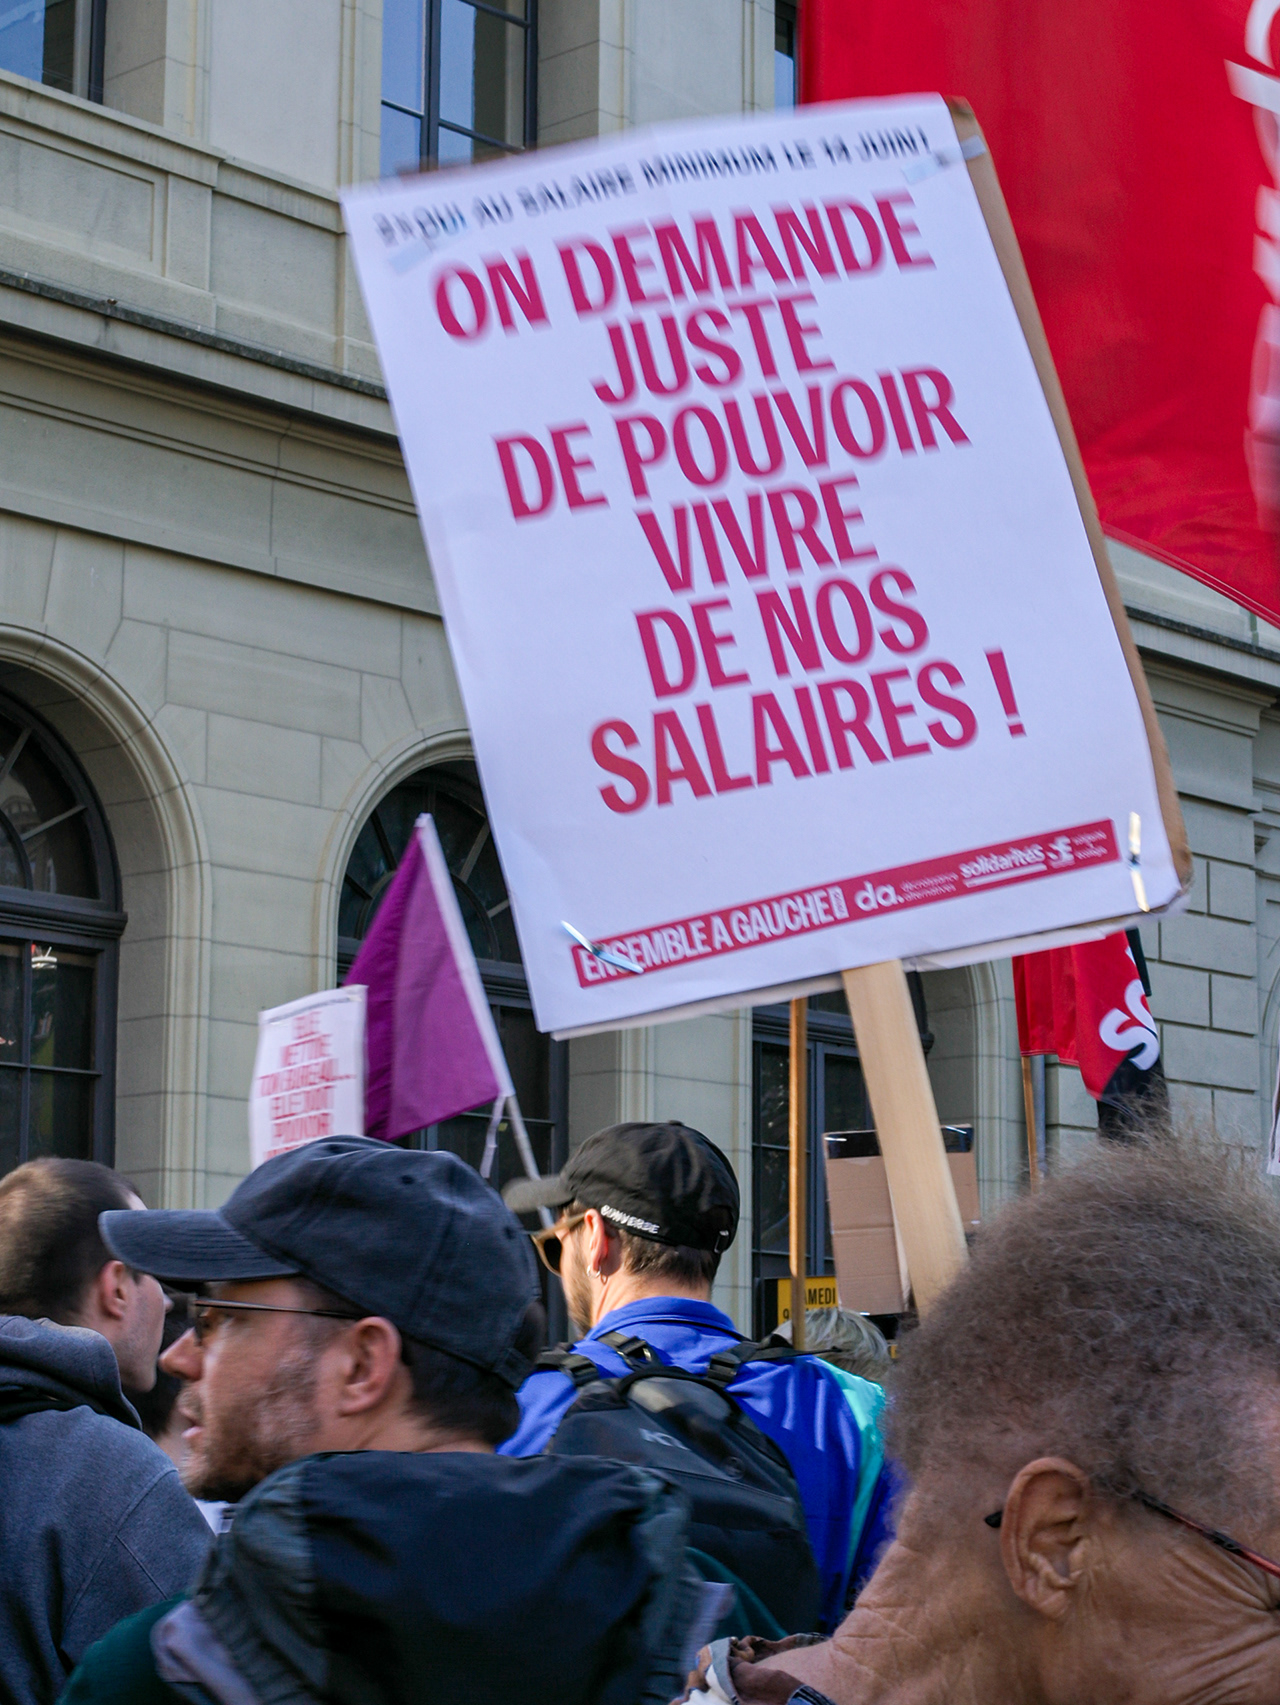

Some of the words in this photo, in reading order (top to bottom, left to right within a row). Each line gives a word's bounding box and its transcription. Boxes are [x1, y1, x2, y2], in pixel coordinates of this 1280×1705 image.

[473, 195, 516, 230] AU
[519, 164, 640, 218] SALAIRE
[640, 142, 781, 190] MINIMUM
[784, 138, 817, 170] LE
[431, 247, 550, 346] ON
[555, 187, 937, 322] DEMANDE
[590, 292, 836, 406] JUSTE
[492, 418, 610, 524] DE
[613, 363, 974, 503] POUVOIR
[635, 474, 880, 596] VIVRE
[634, 598, 752, 701] DE
[755, 563, 930, 681] NOS
[589, 660, 979, 816] SALAIRES
[984, 646, 1027, 739] !
[730, 892, 836, 945] GAUCHE
[804, 1287, 836, 1305] MEDI
